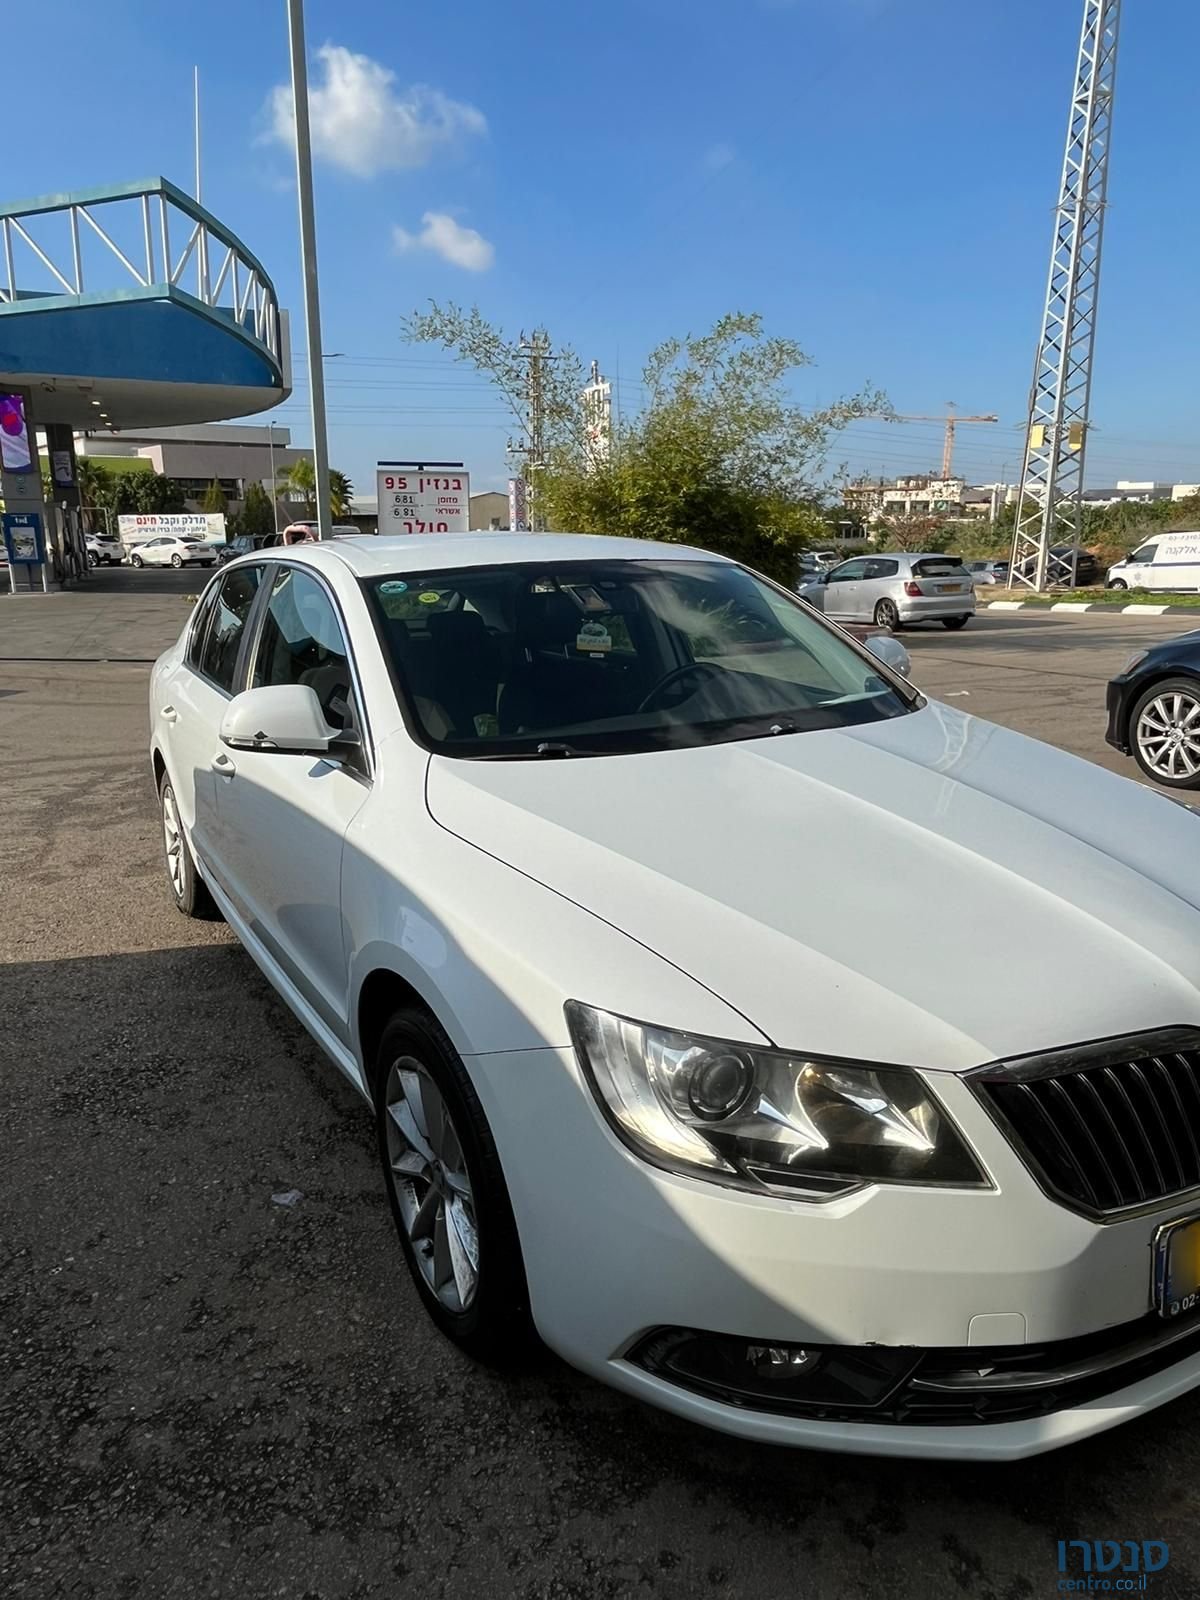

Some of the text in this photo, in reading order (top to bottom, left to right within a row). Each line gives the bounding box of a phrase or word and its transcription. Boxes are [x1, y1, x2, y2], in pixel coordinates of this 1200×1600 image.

[385, 476, 462, 493] בנזין 95
[437, 496, 458, 505] מזומן
[435, 507, 461, 515] אשראי
[136, 516, 157, 525] חינם
[159, 516, 179, 526] וקבל
